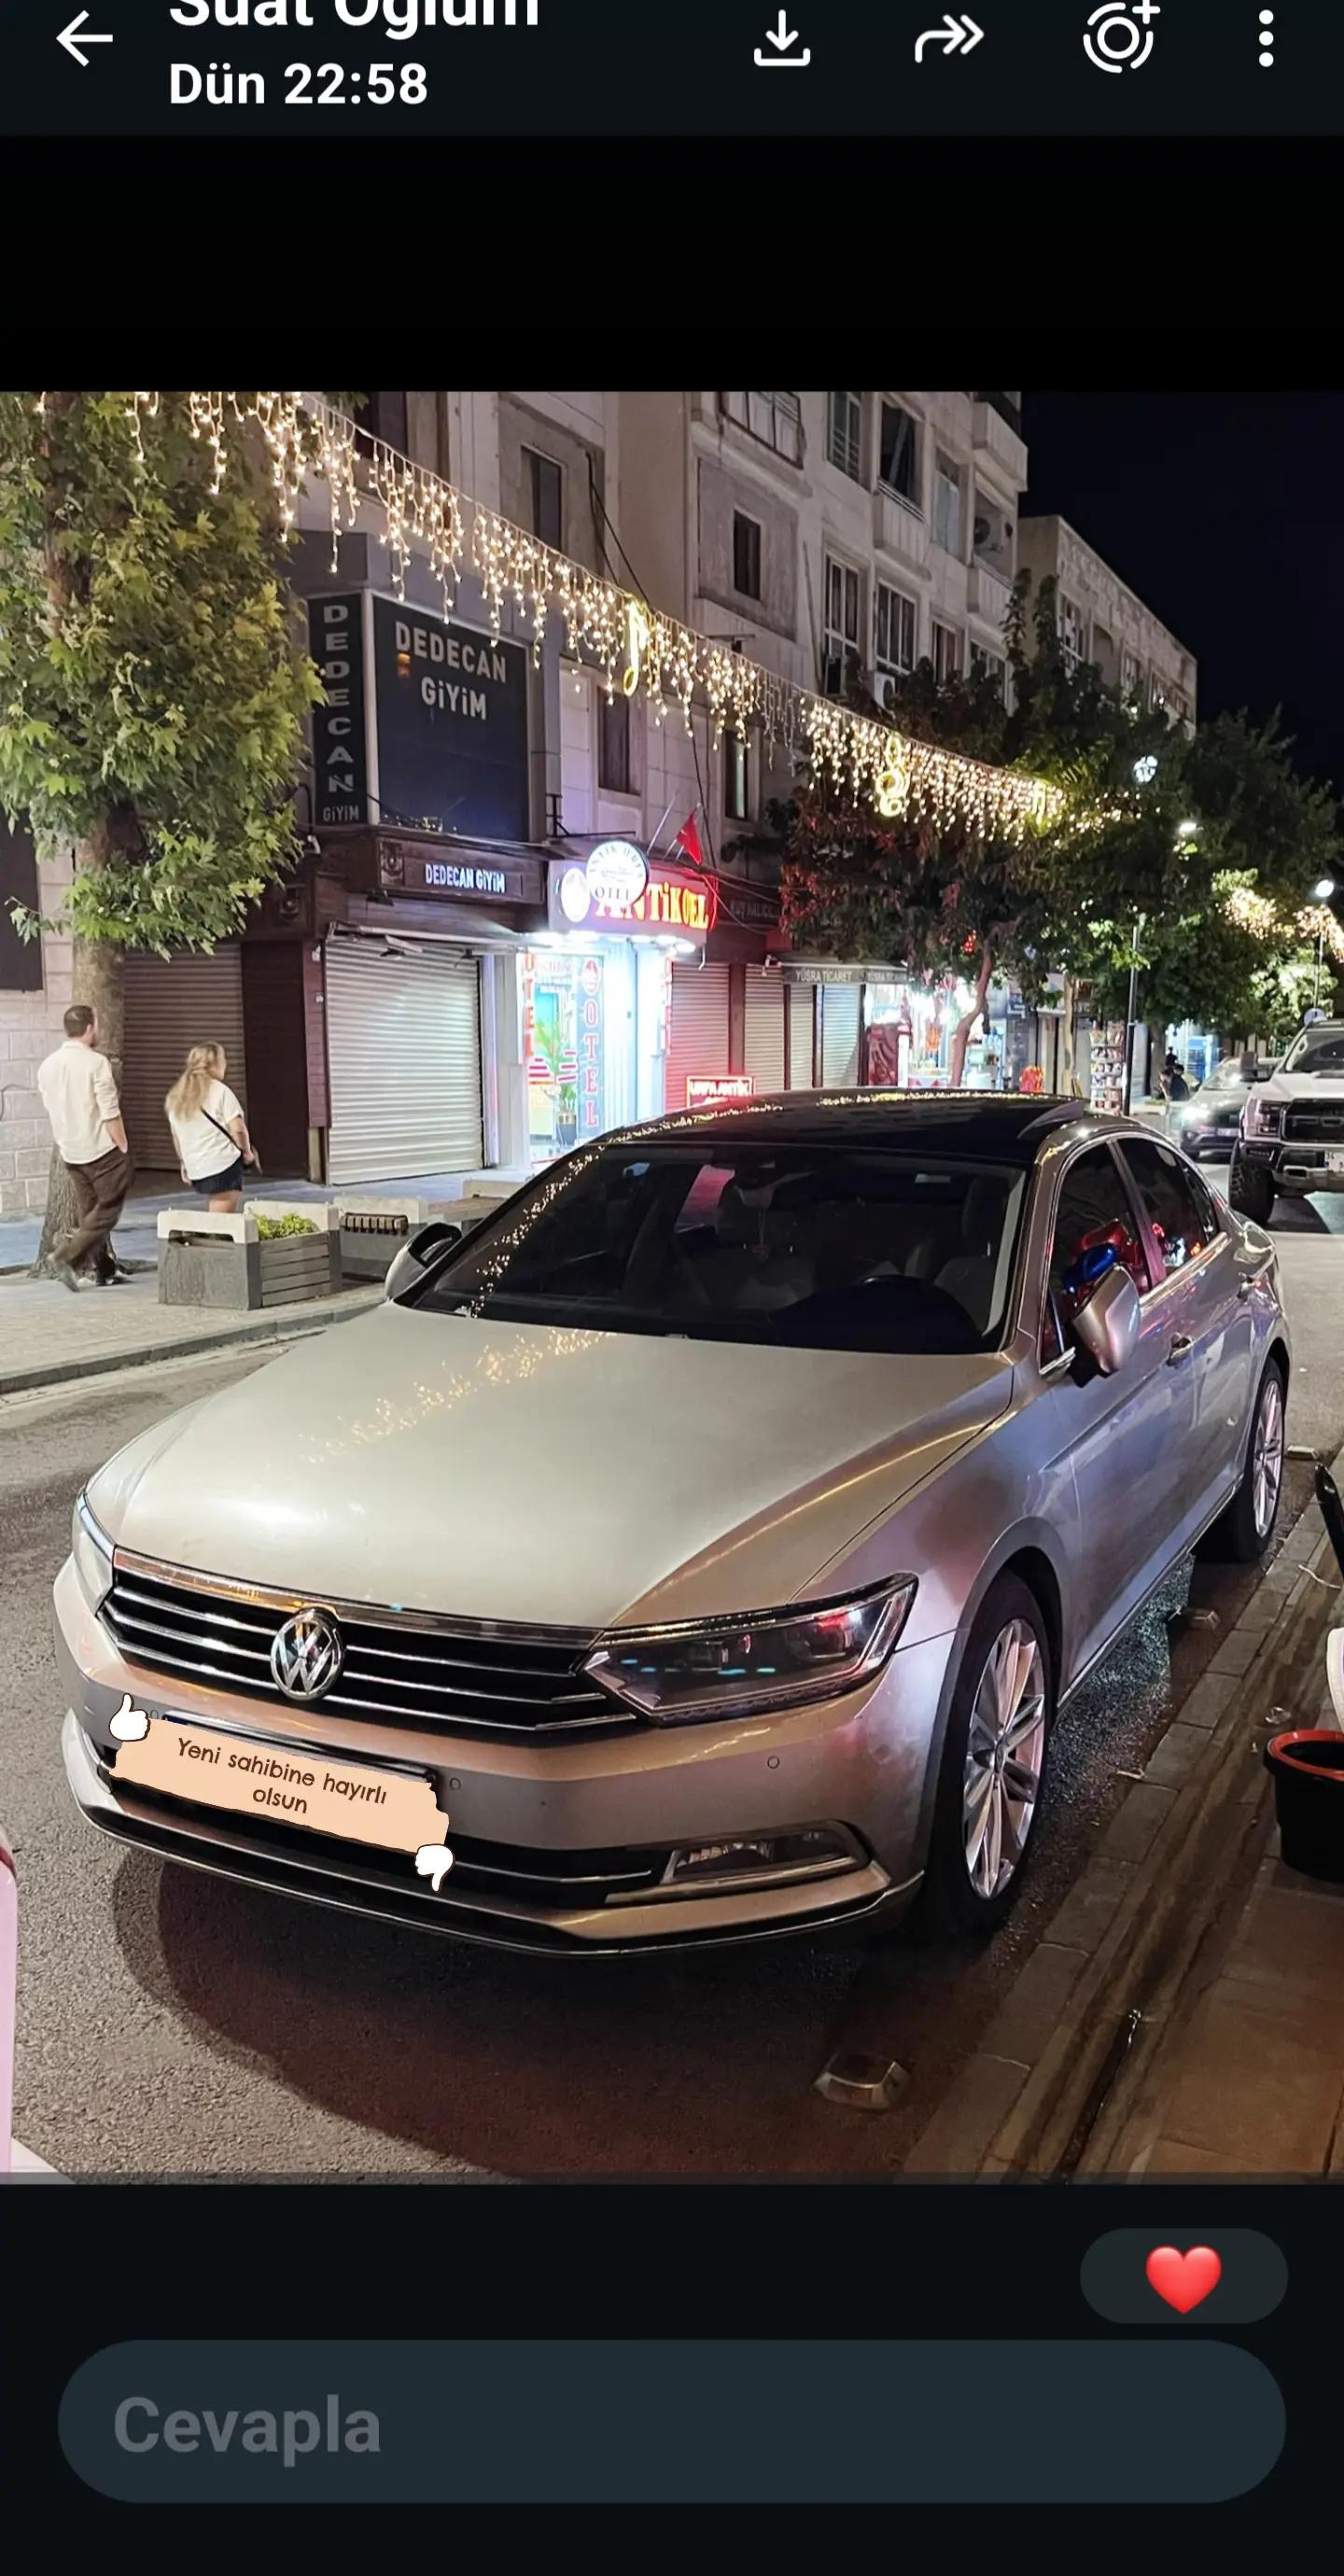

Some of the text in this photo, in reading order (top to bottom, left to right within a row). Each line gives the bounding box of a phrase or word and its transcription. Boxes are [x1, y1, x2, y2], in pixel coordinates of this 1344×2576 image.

[323, 605, 355, 792] DEDECAN
[396, 623, 507, 682] DEDECAN
[425, 863, 474, 889] DEDECAN
[585, 1000, 599, 1127] OTEL
